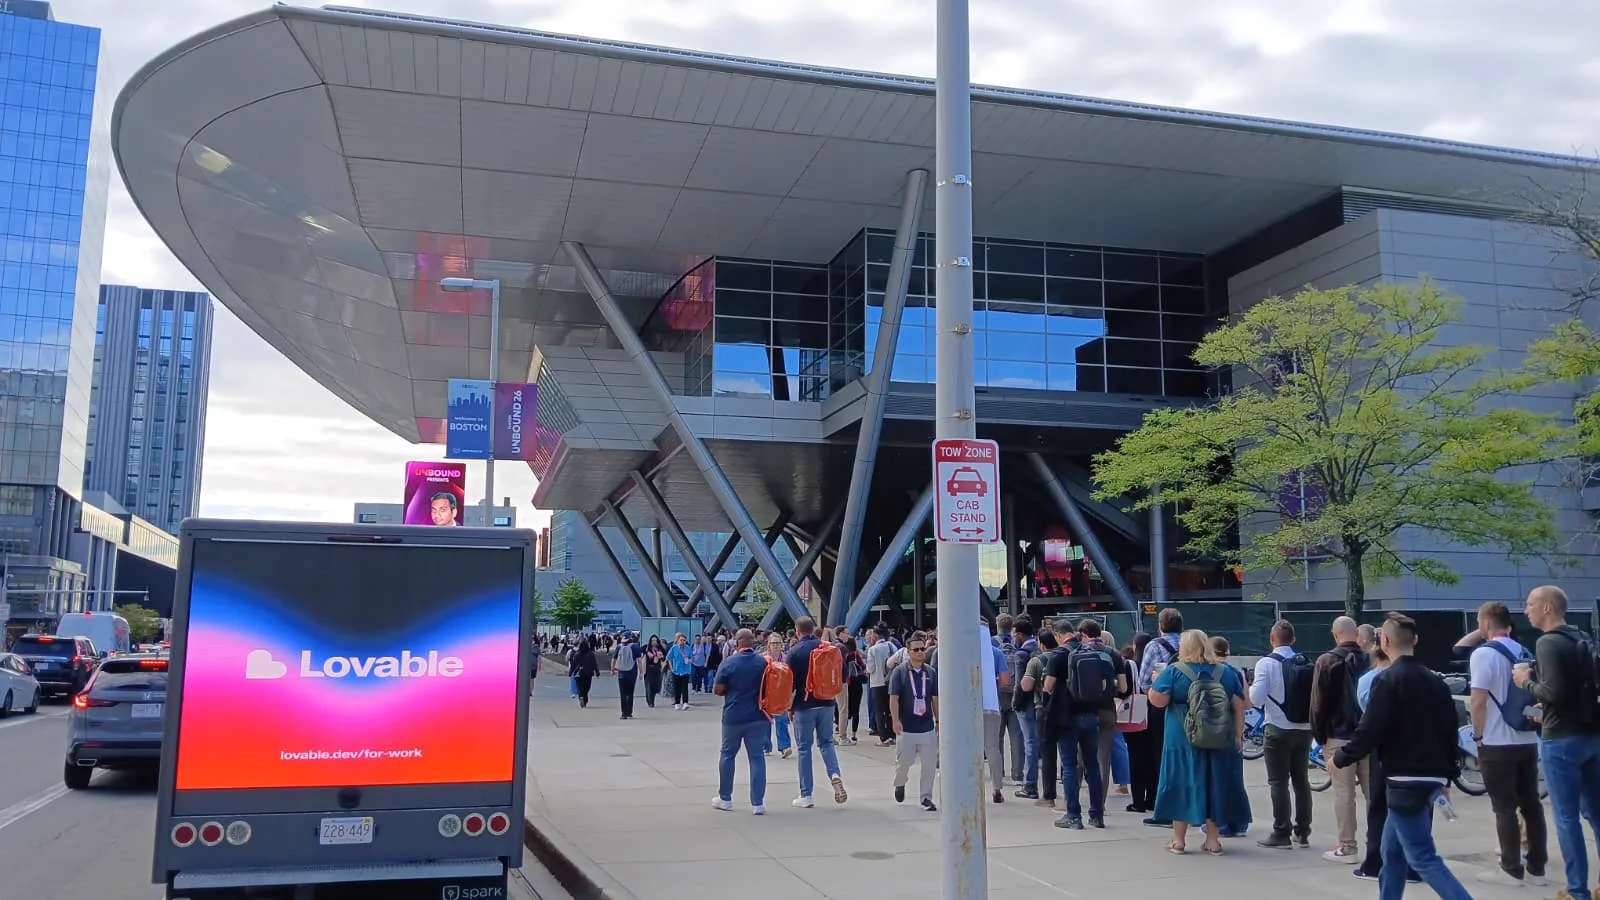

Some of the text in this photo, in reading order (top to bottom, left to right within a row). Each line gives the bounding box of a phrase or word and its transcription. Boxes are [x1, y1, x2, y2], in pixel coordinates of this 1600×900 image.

[449, 422, 488, 432] BOSTON
[940, 447, 992, 458] TOW ZONE
[415, 469, 461, 477] UNBOUND
[956, 500, 980, 510] CAB
[950, 513, 986, 523] STAND
[300, 650, 464, 678] Lovable
[280, 748, 422, 760] lovable.dev/for-work
[462, 887, 502, 899] spark
